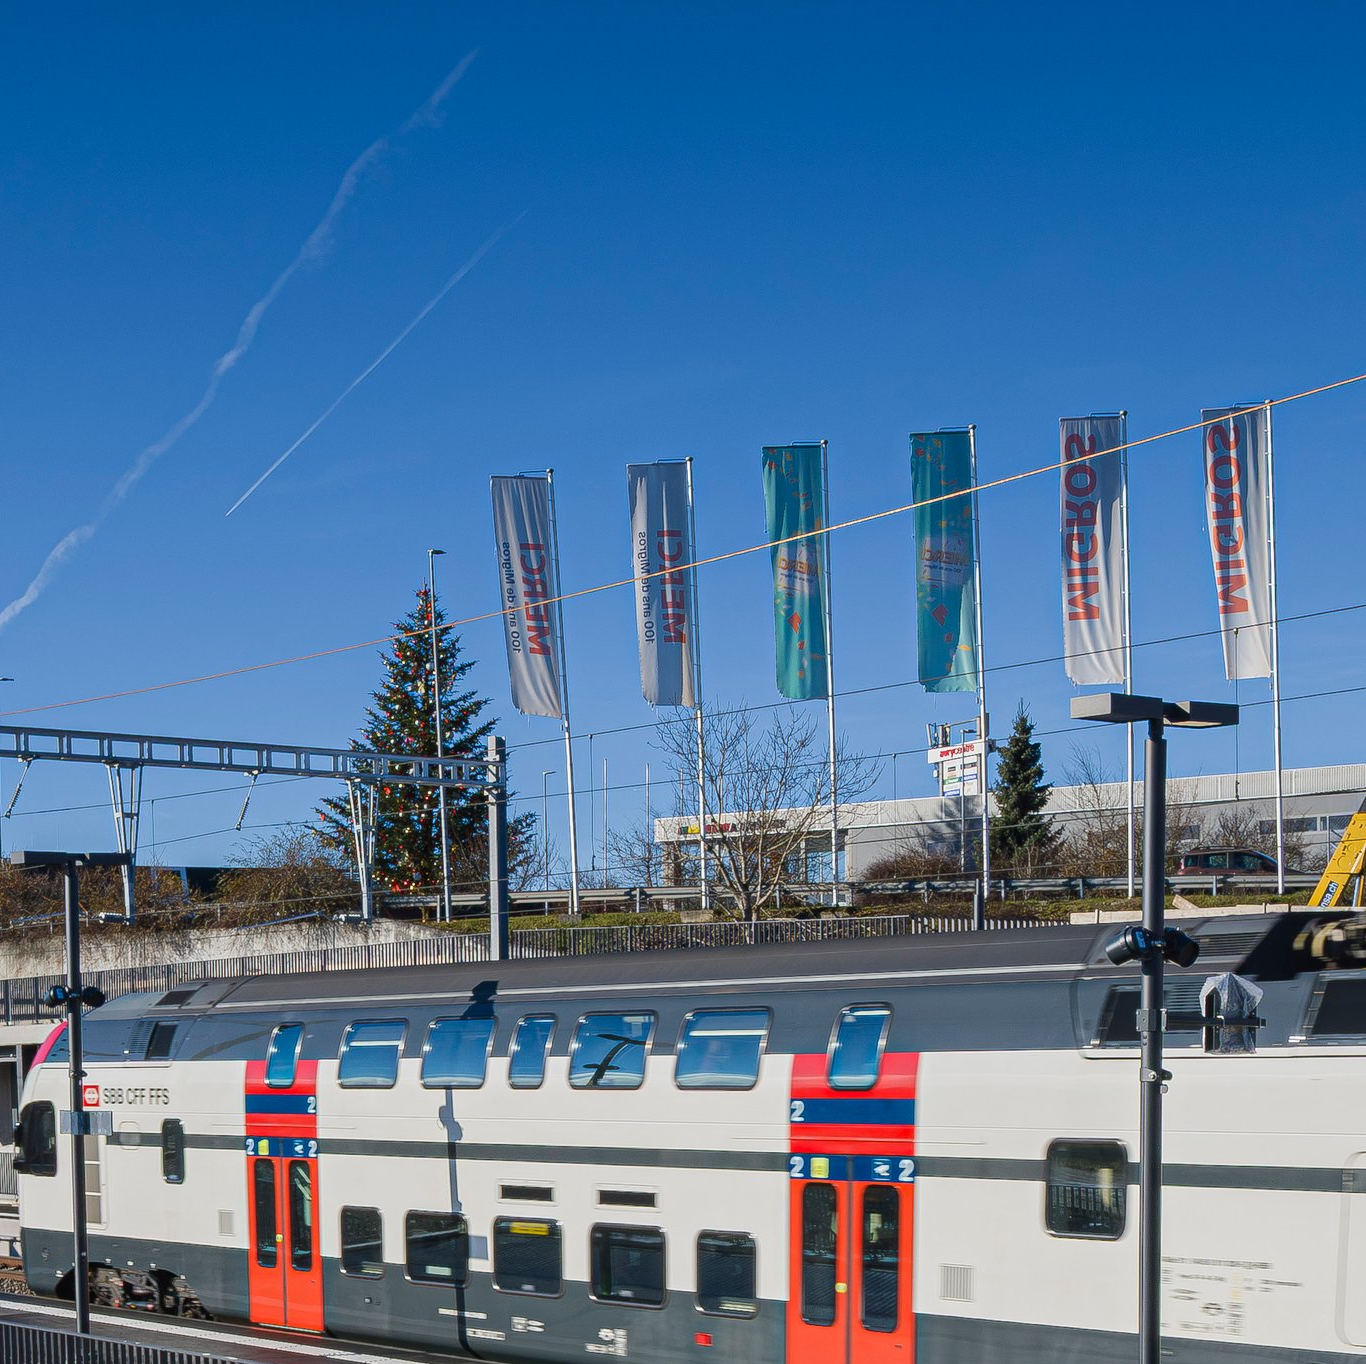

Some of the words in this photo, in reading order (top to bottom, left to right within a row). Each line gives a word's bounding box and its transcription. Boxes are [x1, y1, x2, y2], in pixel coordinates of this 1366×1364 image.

[103, 1088, 124, 1104] SBB
[126, 1088, 146, 1104] CFF
[149, 1088, 170, 1105] FFS
[307, 1096, 316, 1113] 2
[790, 1100, 805, 1121] 2
[246, 1138, 255, 1155] 2
[308, 1140, 317, 1157] 2
[789, 1156, 804, 1178] 2
[898, 1159, 915, 1182] 2
